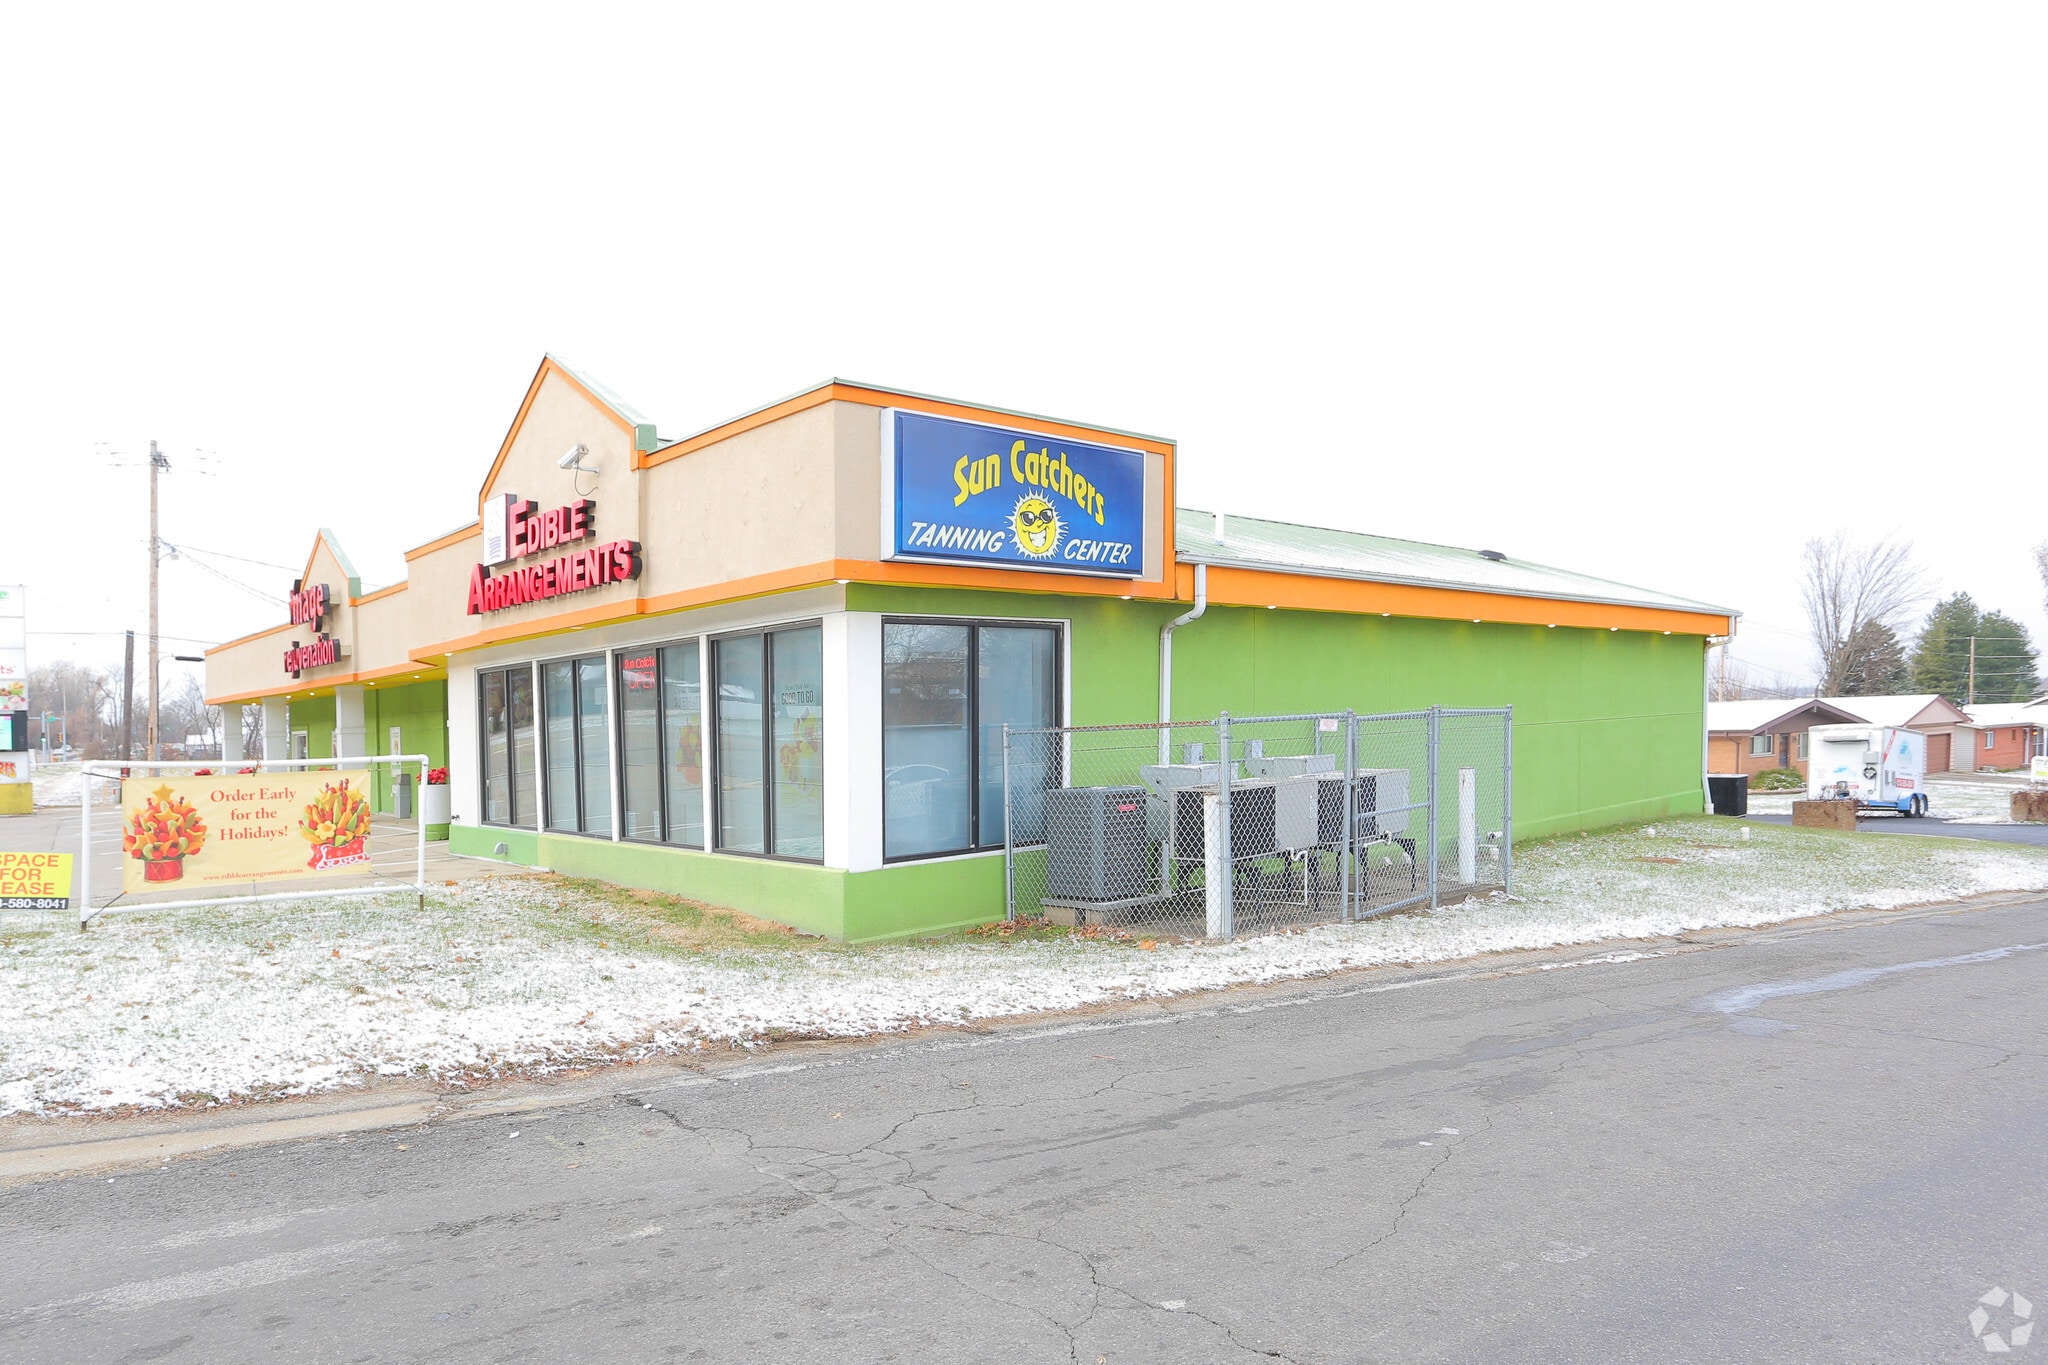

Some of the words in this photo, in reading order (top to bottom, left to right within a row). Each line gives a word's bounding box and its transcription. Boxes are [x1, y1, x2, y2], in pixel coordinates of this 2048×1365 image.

[953, 453, 1001, 508] Sun
[1009, 439, 1105, 527] Catchers
[509, 499, 592, 559] EDIBLE
[906, 521, 1006, 553] TANNING
[1063, 538, 1132, 565] CENTER
[467, 539, 639, 617] ARRANGEMENTS
[797, 691, 805, 704] TO
[210, 789, 255, 803] Order
[259, 787, 297, 803] Early
[230, 808, 252, 821] for
[255, 807, 278, 820] the
[220, 825, 288, 842] Holidays!
[0, 854, 60, 868] PACE
[0, 868, 42, 881] FOR
[202, 868, 304, 881] www.ediblearrangements.com
